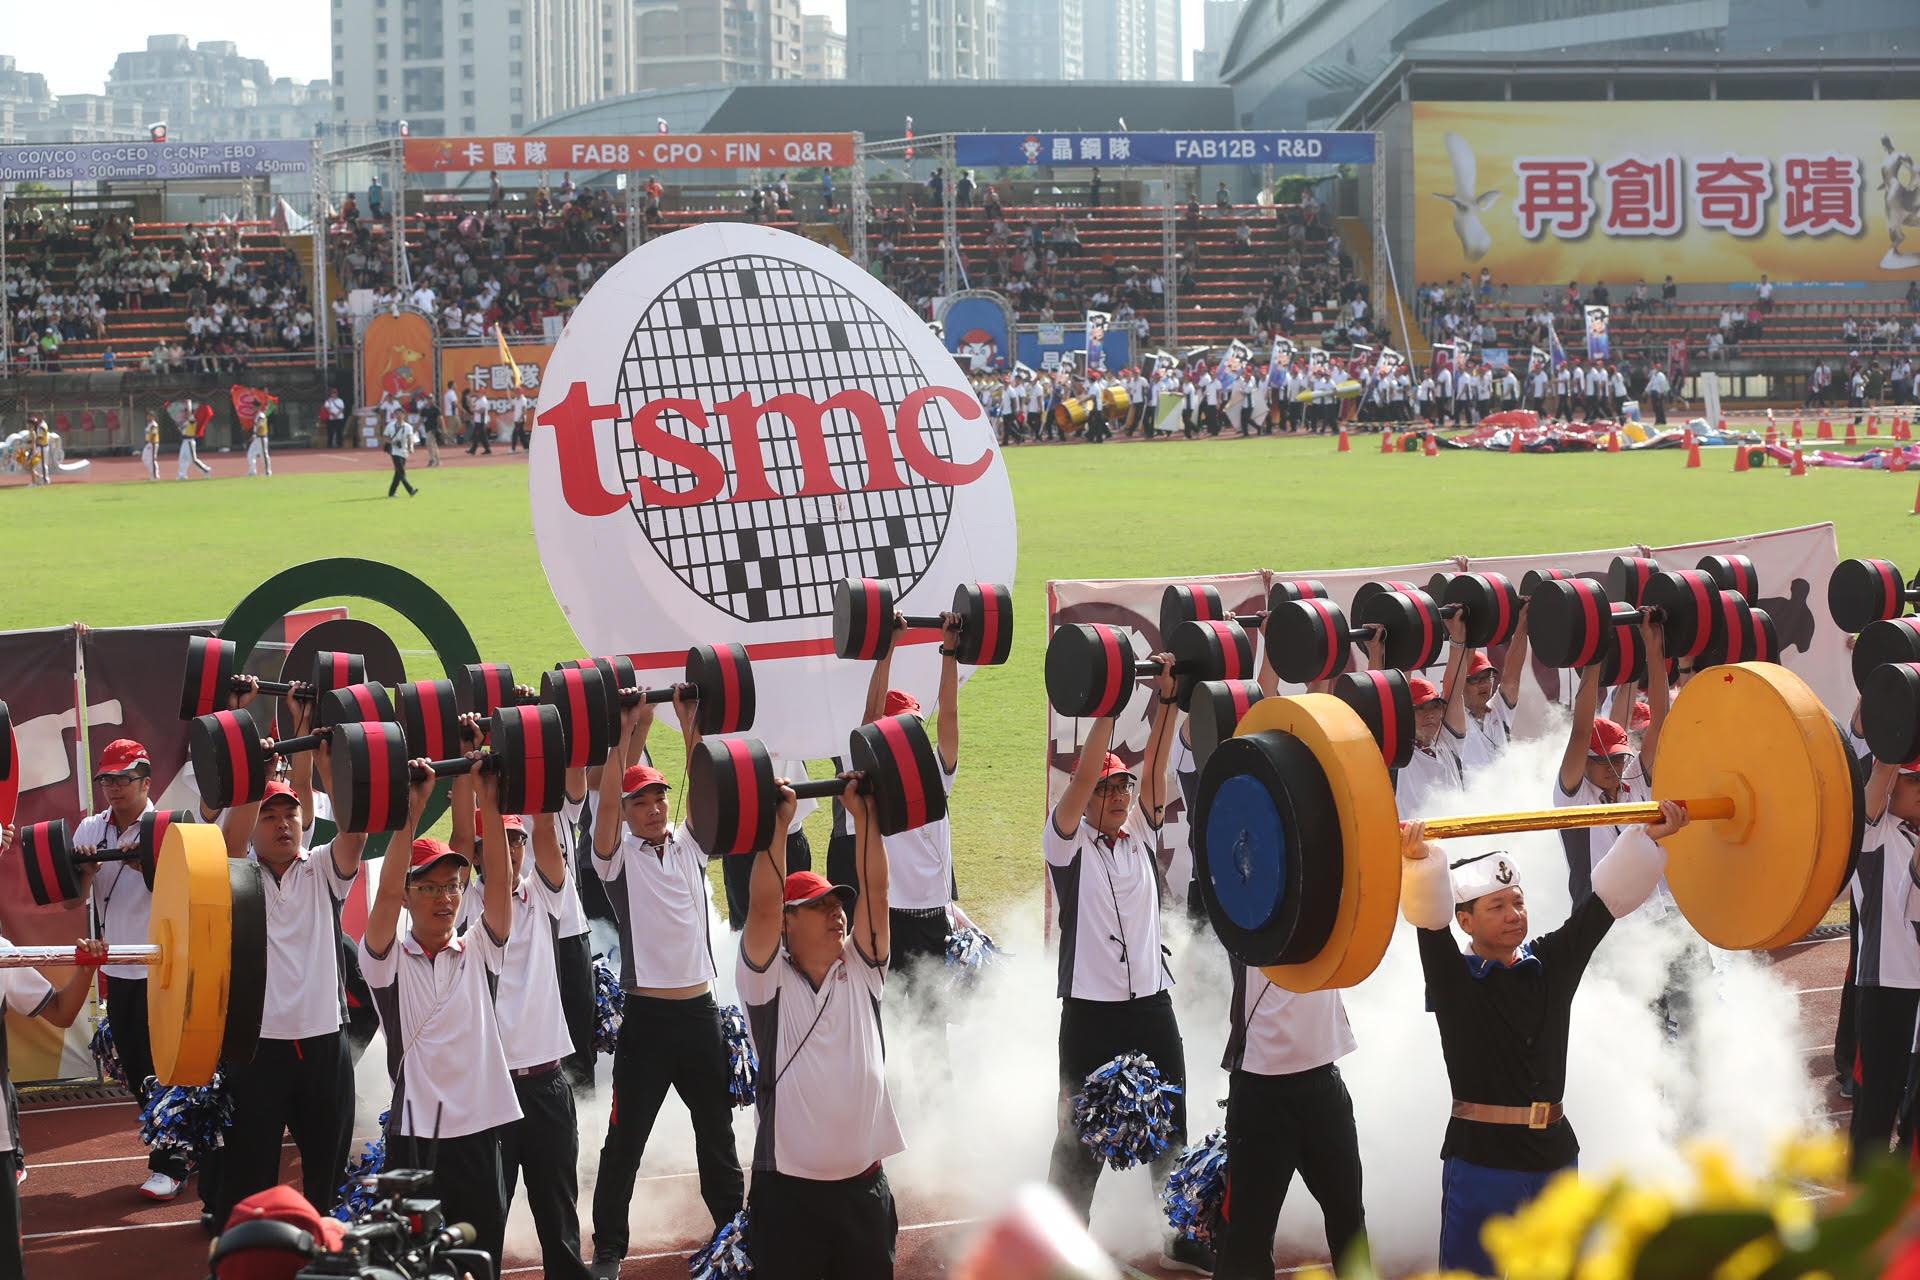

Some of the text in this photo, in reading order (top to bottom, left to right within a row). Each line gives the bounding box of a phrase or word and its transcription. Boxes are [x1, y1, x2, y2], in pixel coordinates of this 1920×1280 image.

[462, 141, 547, 166] 卡歐隊
[783, 142, 833, 162] Q&R
[1052, 137, 1131, 160] 晶鋼隊
[1277, 138, 1322, 157] R&D
[255, 160, 305, 173] 450mm
[1515, 154, 1858, 234] 再創奇蹟
[537, 381, 994, 517] tsmc
